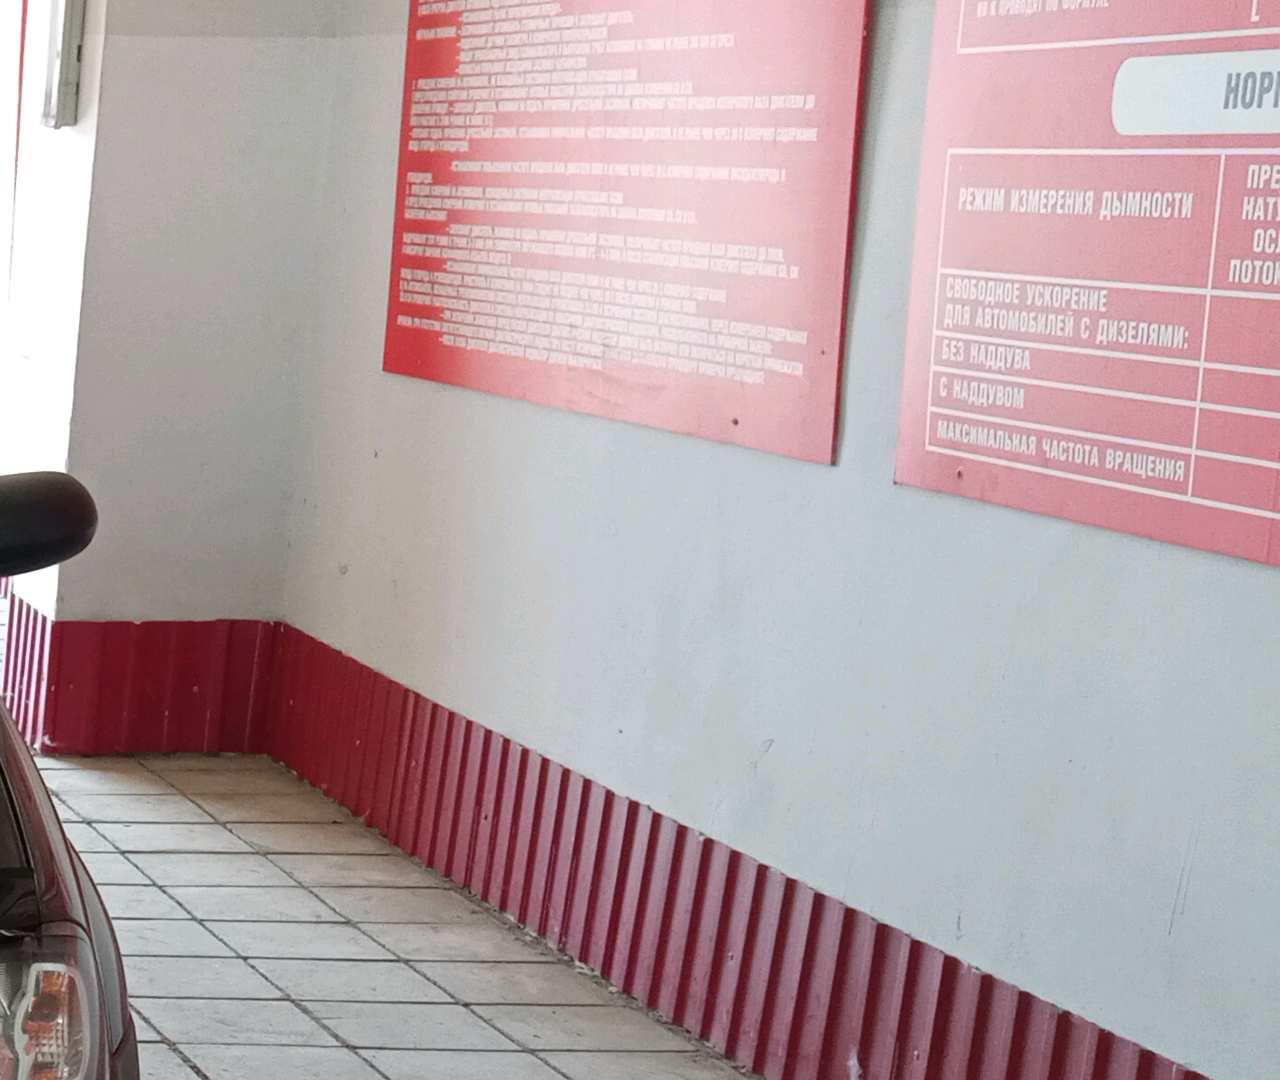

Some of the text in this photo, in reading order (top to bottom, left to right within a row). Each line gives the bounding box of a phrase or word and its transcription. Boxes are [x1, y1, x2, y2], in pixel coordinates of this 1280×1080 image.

[1223, 71, 1280, 110] НОР
[958, 187, 1193, 220] РЕЖИМ ИЗМЕРЕНИЯ ДЫМНОСТИ
[945, 276, 1108, 312] СВОБОДНОЕ УСКОРЕНИЕ
[943, 303, 1189, 349] ДЛЯ АВТОМОБИЛЕЙ С ДИЗЕЛЯМИ:
[942, 339, 1031, 370] БЕЗ НАДДУВА
[940, 376, 1025, 409] С НАДДУВОМ
[937, 420, 1185, 482] МАКСИМАЛЬНАЯ ЧАСТОТА ВРАЩЕНИЯ
